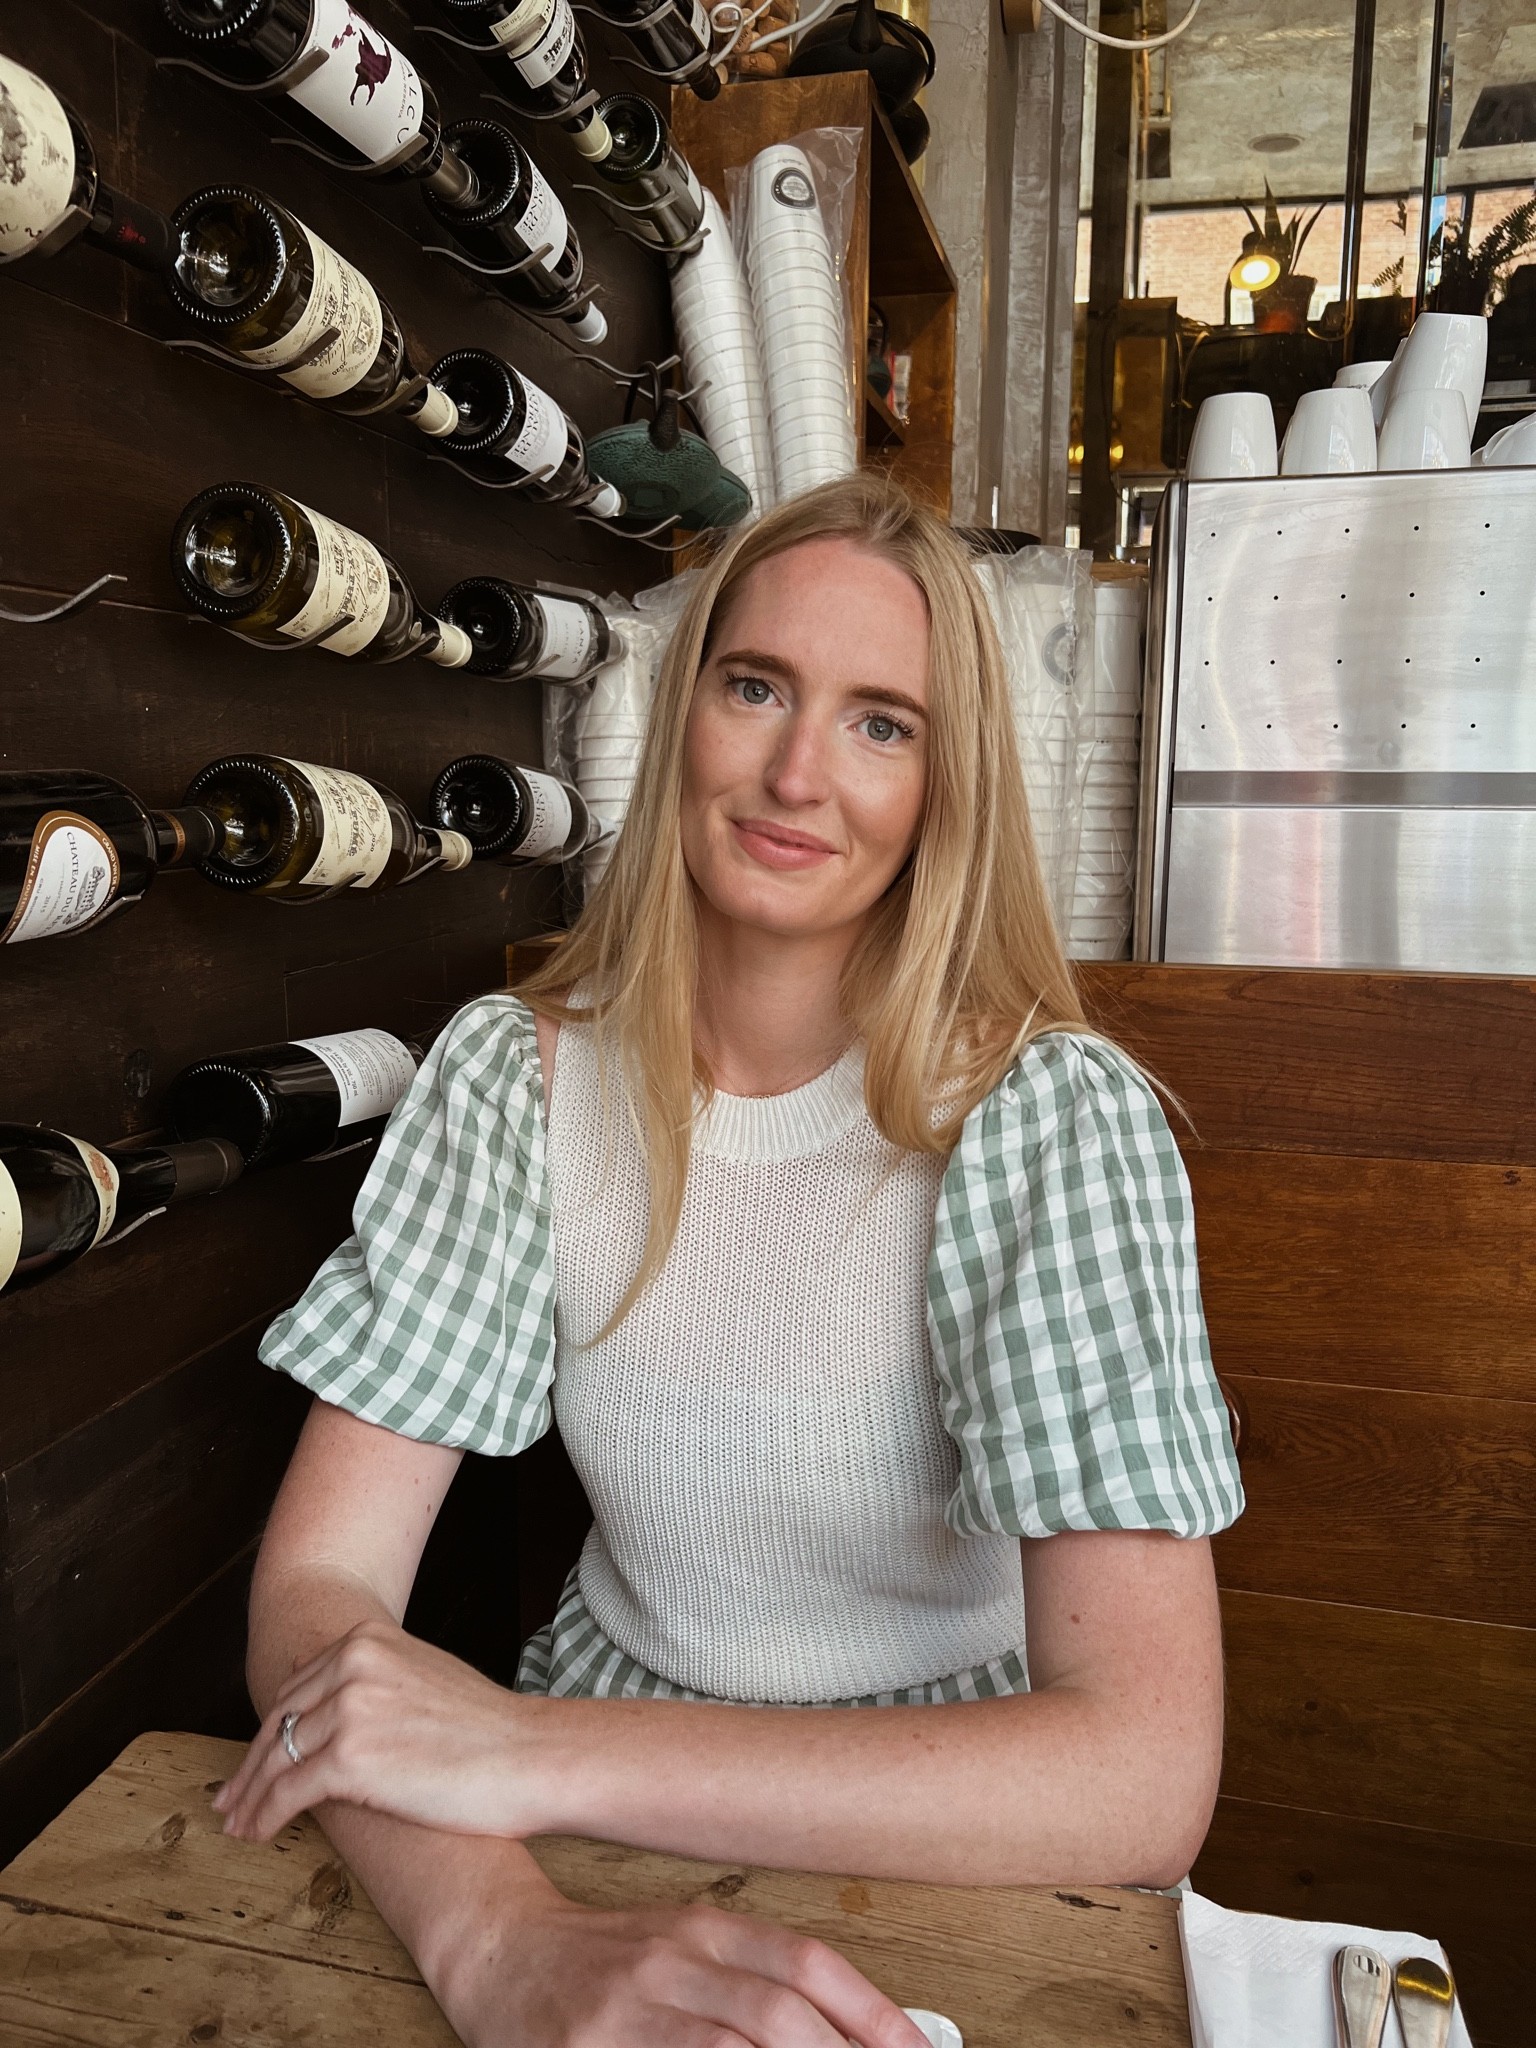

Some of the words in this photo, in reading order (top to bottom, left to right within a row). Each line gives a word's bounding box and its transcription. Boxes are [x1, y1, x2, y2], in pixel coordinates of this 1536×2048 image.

[330, 361, 349, 376] 2020
[358, 604, 370, 624] 2020
[369, 833, 377, 853] 2020
[32, 845, 42, 864] MISE
[66, 831, 80, 894] CHATEAU
[102, 837, 115, 863] GRAND
[112, 876, 119, 885] DE
[29, 864, 37, 877] EN
[60, 895, 74, 913] DU
